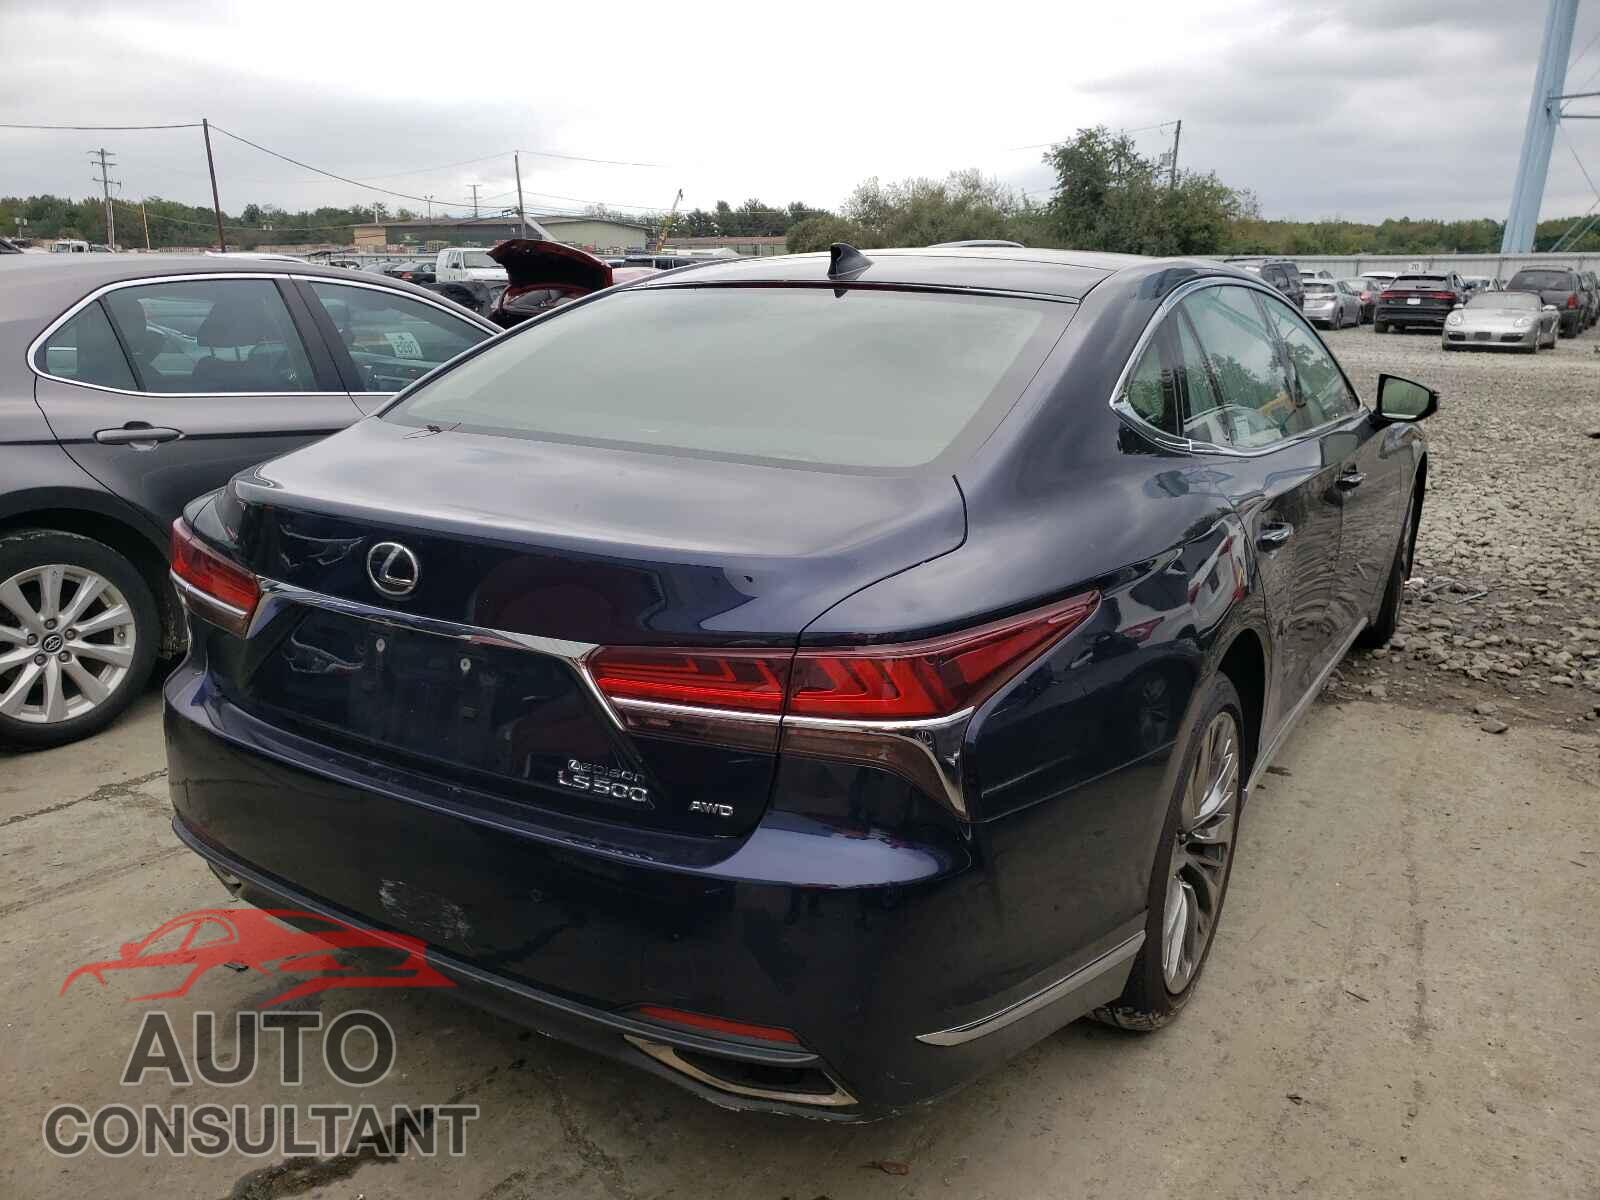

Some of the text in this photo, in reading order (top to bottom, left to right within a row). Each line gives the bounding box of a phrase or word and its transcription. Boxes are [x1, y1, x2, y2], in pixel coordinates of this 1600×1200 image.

[558, 770, 648, 802] LS 500
[689, 800, 734, 817] AWD
